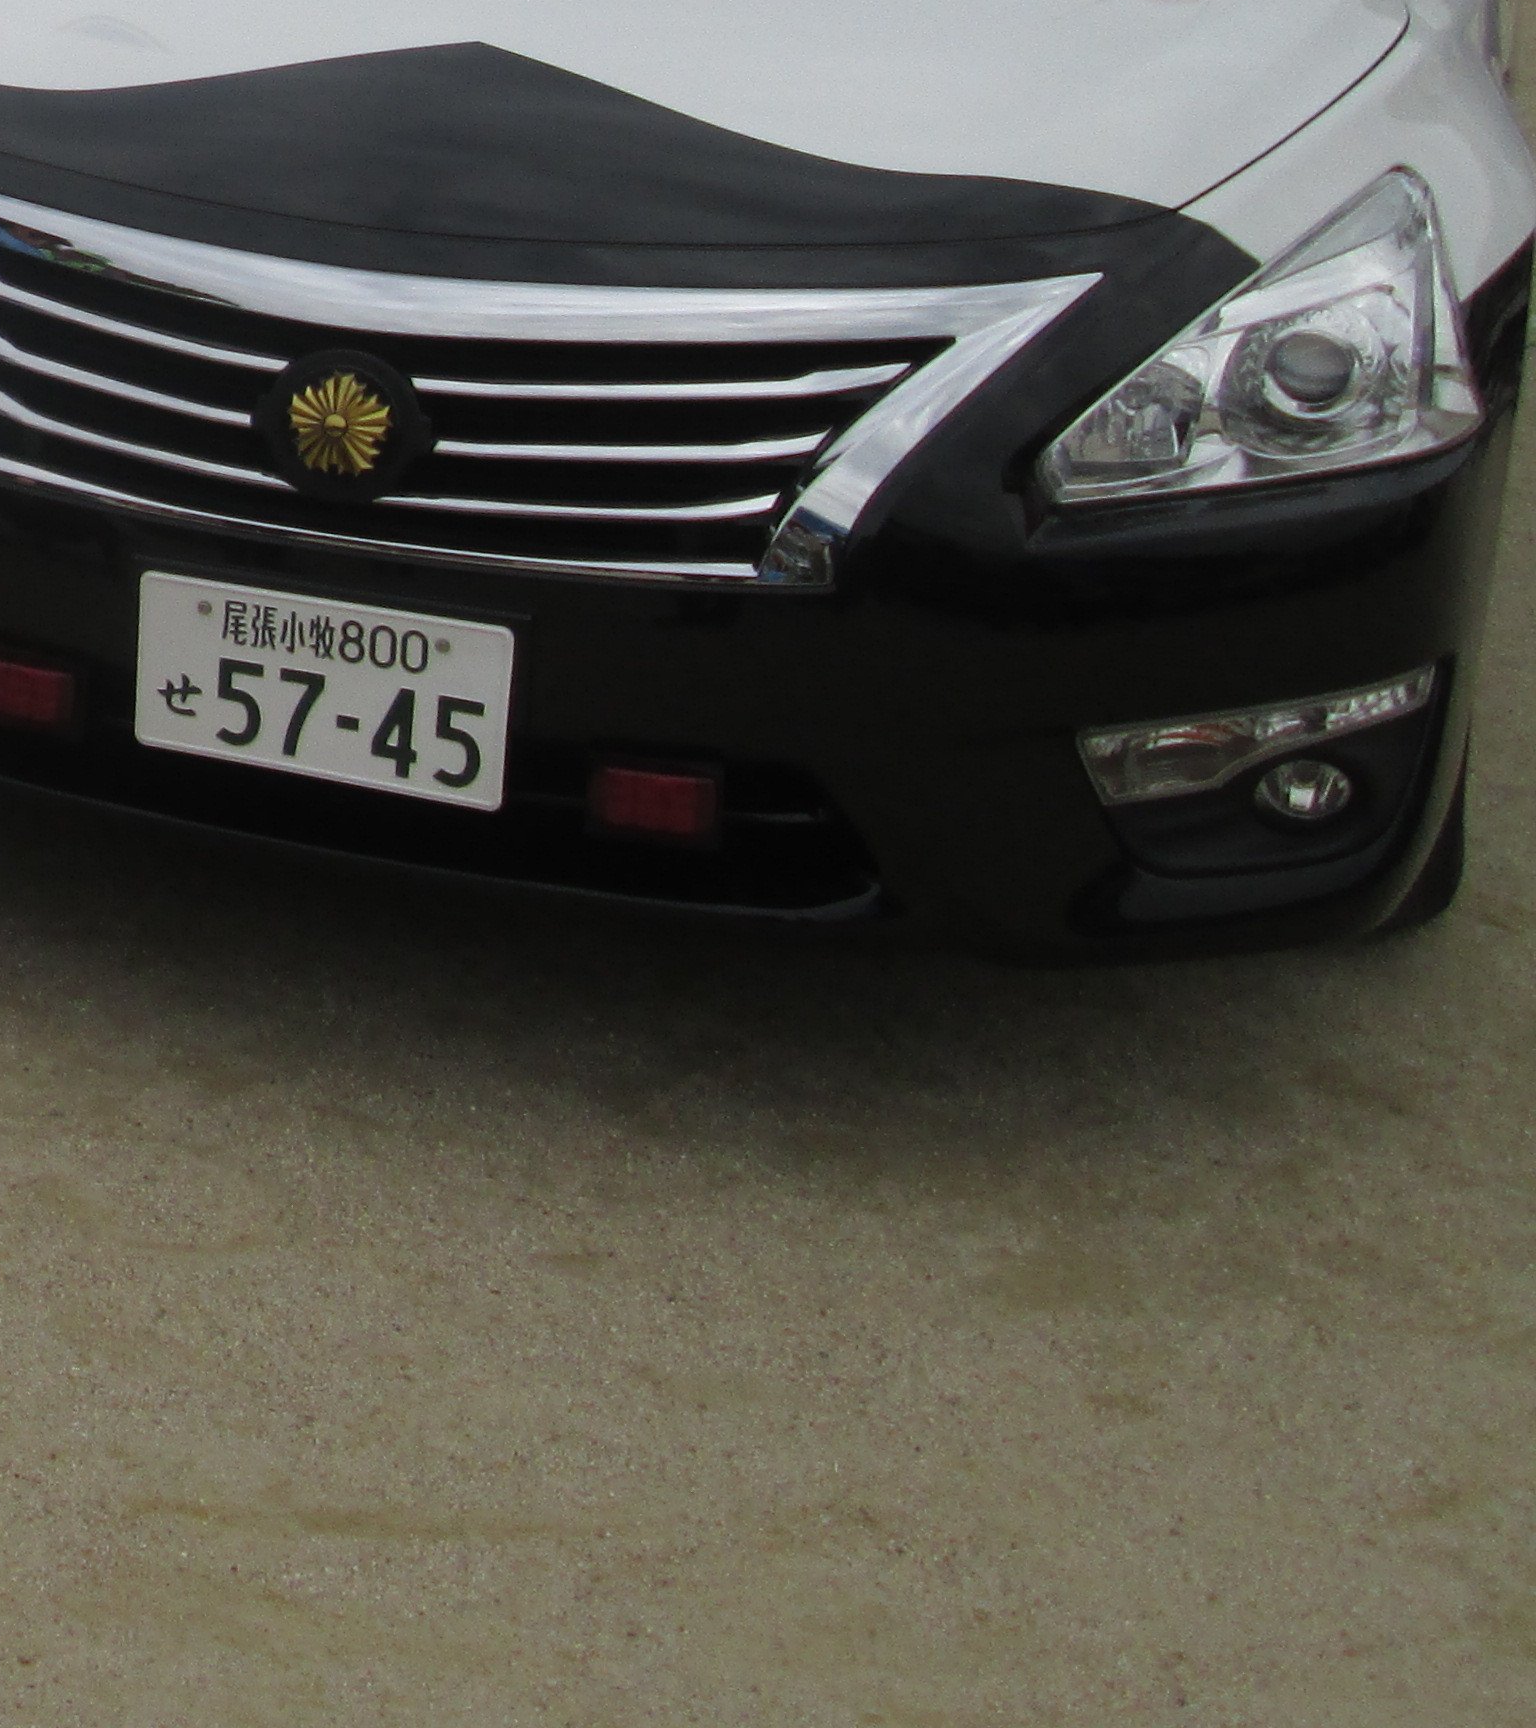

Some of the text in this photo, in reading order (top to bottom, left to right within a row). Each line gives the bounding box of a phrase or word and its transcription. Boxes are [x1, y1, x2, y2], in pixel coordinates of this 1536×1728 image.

[222, 599, 429, 674] 尾張小牧800
[157, 656, 486, 788] せ 57-45
